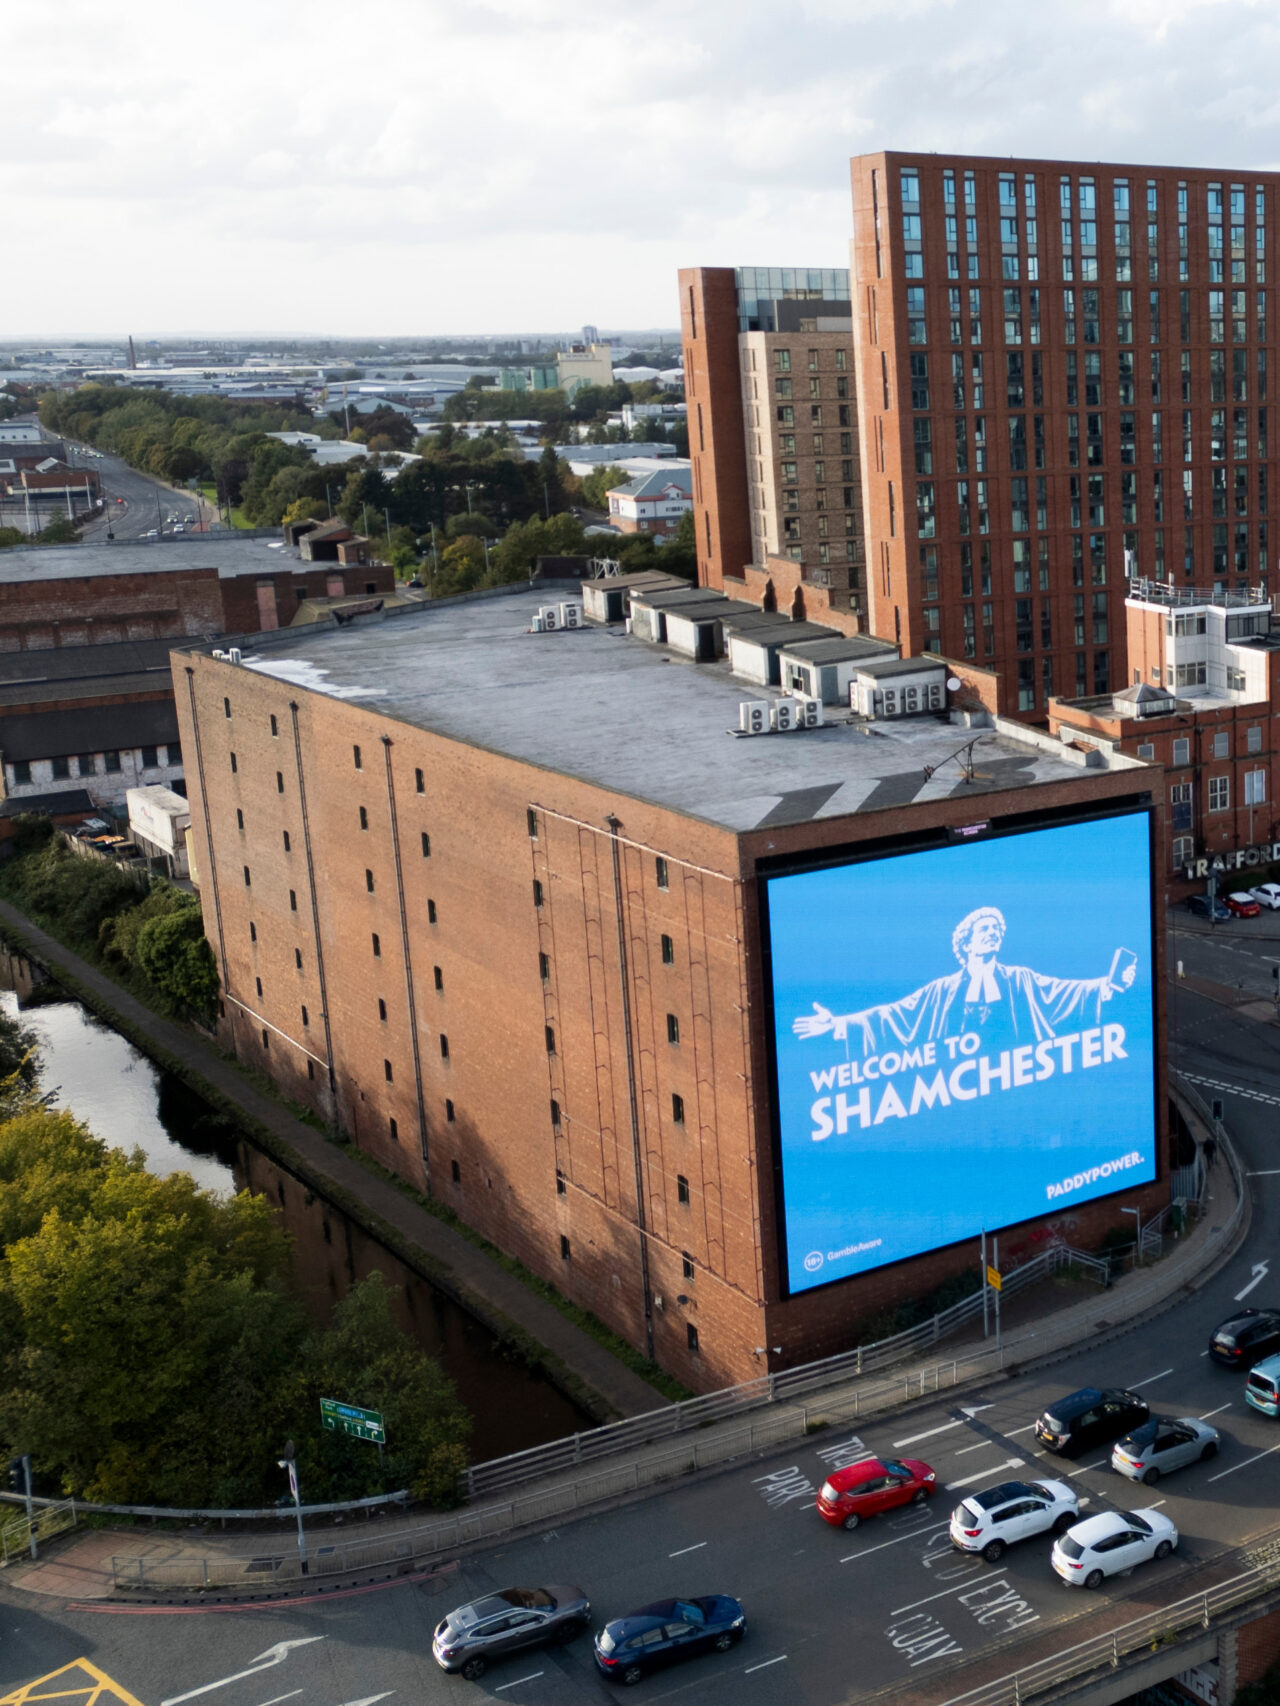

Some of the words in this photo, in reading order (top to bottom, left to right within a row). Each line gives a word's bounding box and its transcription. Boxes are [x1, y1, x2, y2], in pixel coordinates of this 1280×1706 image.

[810, 1041, 936, 1093] WELCOME
[945, 1032, 981, 1061] TO
[810, 1023, 1129, 1142] SHAMCHESTER
[750, 1465, 819, 1510] PARK
